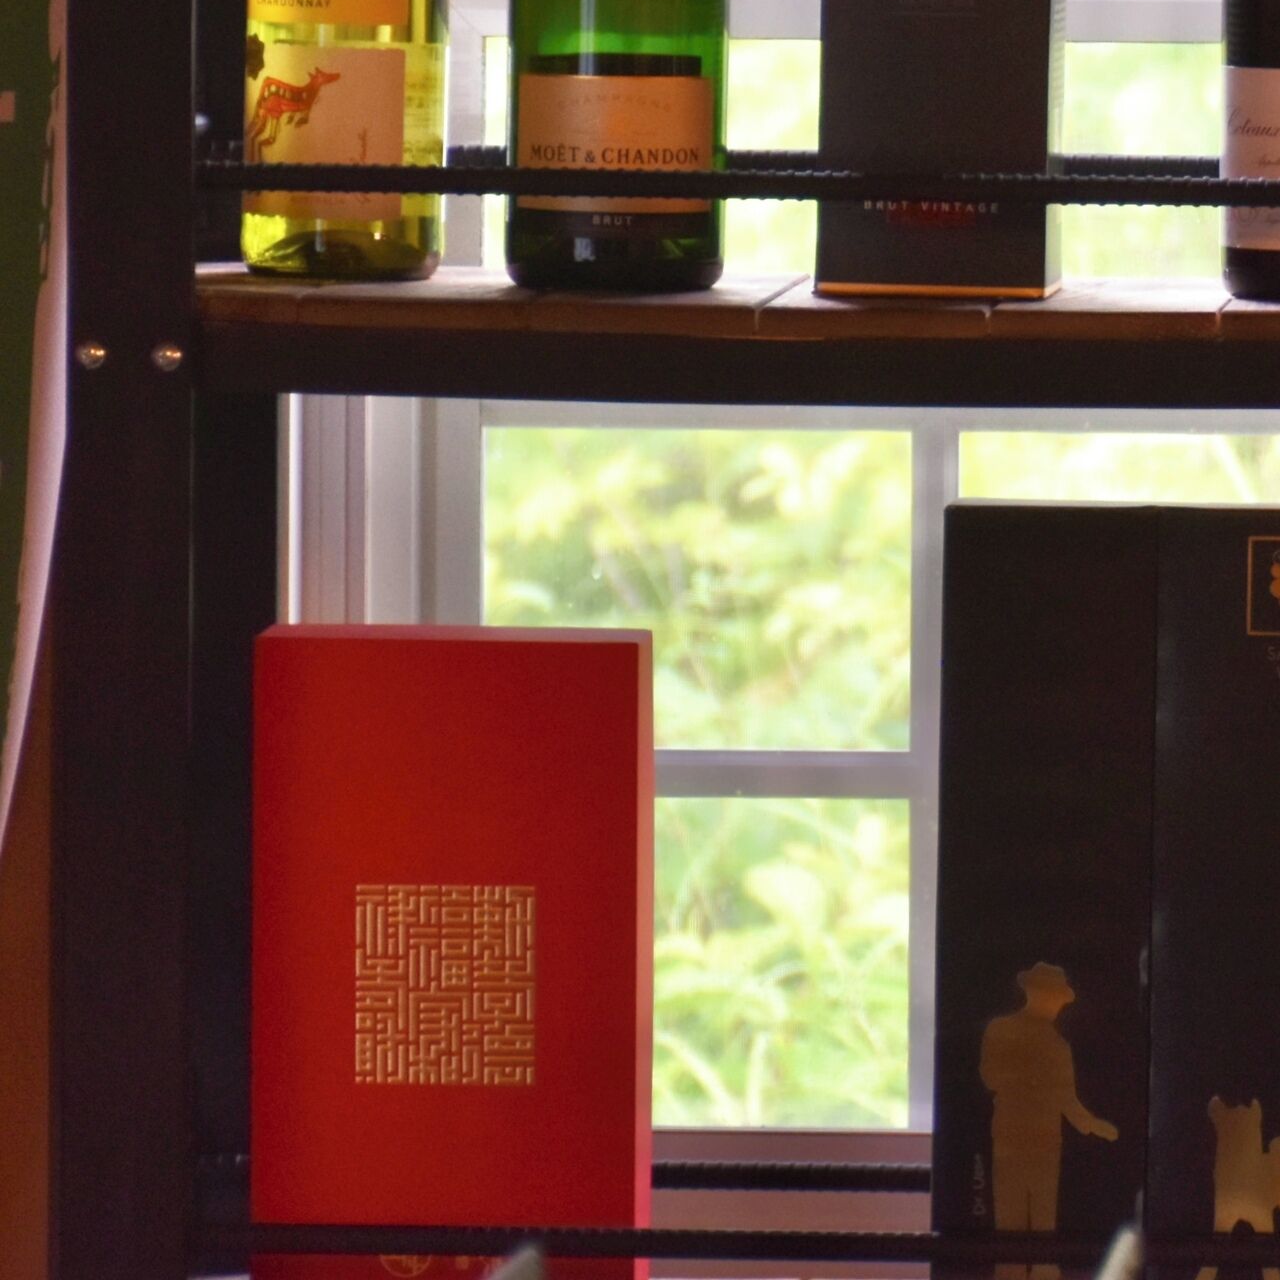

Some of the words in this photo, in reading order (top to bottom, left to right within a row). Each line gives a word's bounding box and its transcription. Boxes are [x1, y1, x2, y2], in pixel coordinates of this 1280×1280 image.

[585, 151, 596, 163] &
[602, 147, 700, 165] CHANDON
[863, 199, 909, 211] BRUT
[921, 201, 999, 213] VINTAGE
[592, 215, 634, 226] BRUT
